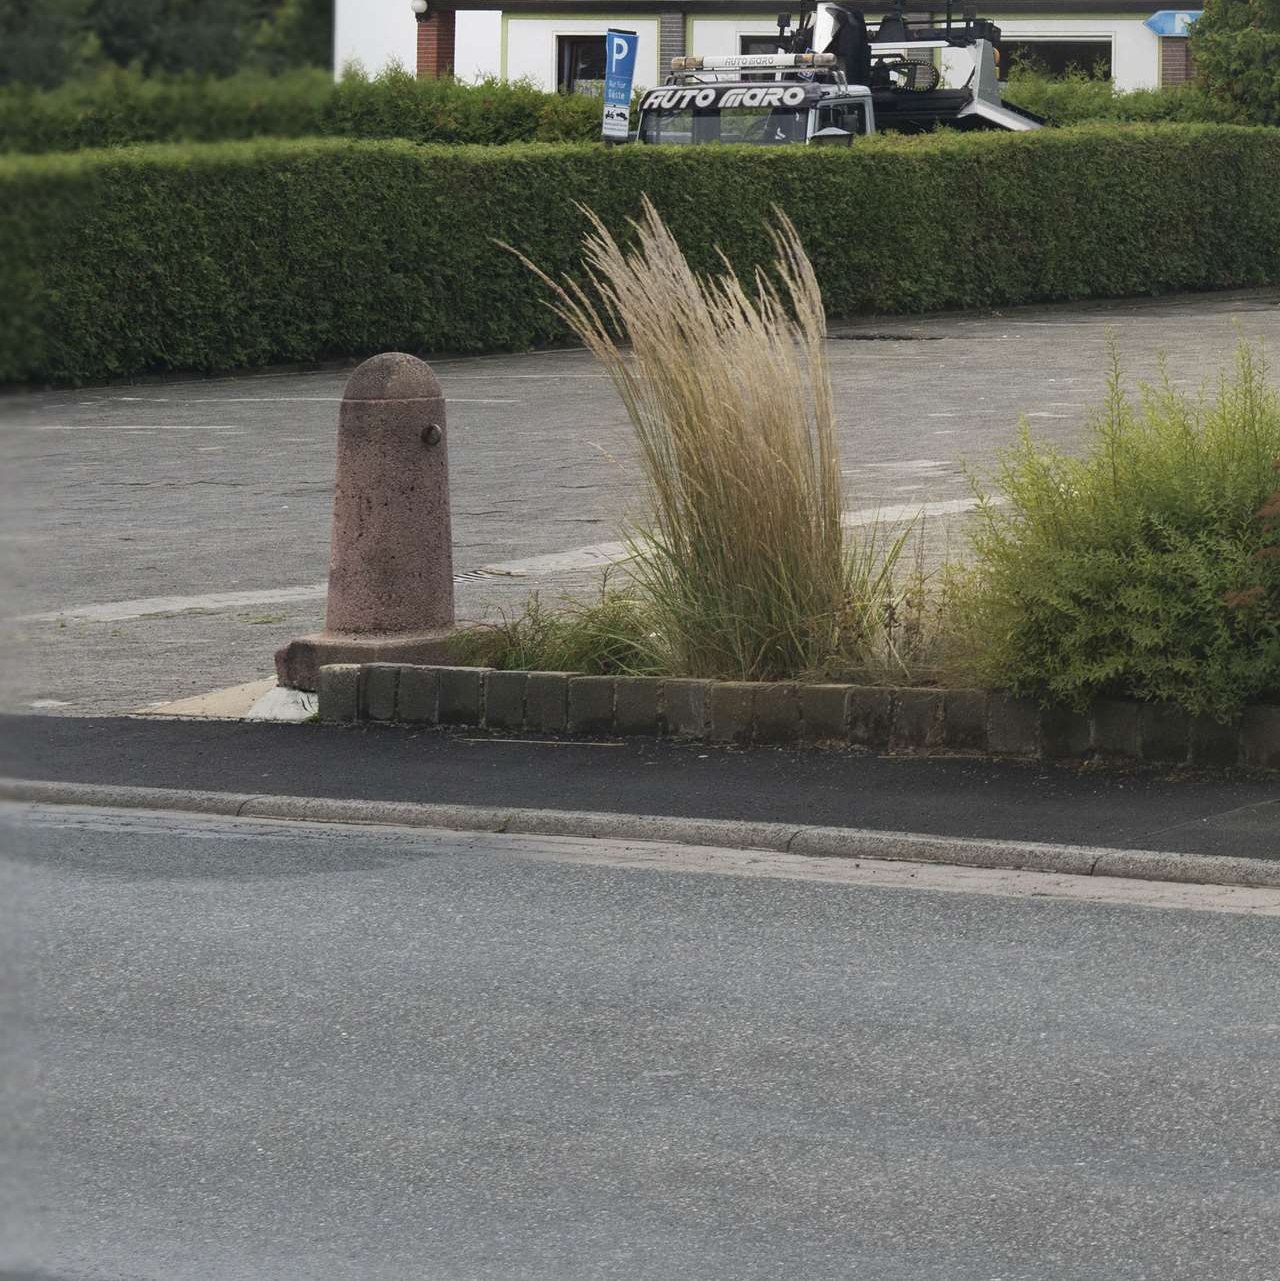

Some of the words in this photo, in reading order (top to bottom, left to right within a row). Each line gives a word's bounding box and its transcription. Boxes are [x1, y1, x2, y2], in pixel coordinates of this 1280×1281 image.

[612, 37, 629, 73] P
[724, 57, 748, 66] AUTO
[643, 88, 716, 110] AUTO
[718, 87, 805, 108] MARO
